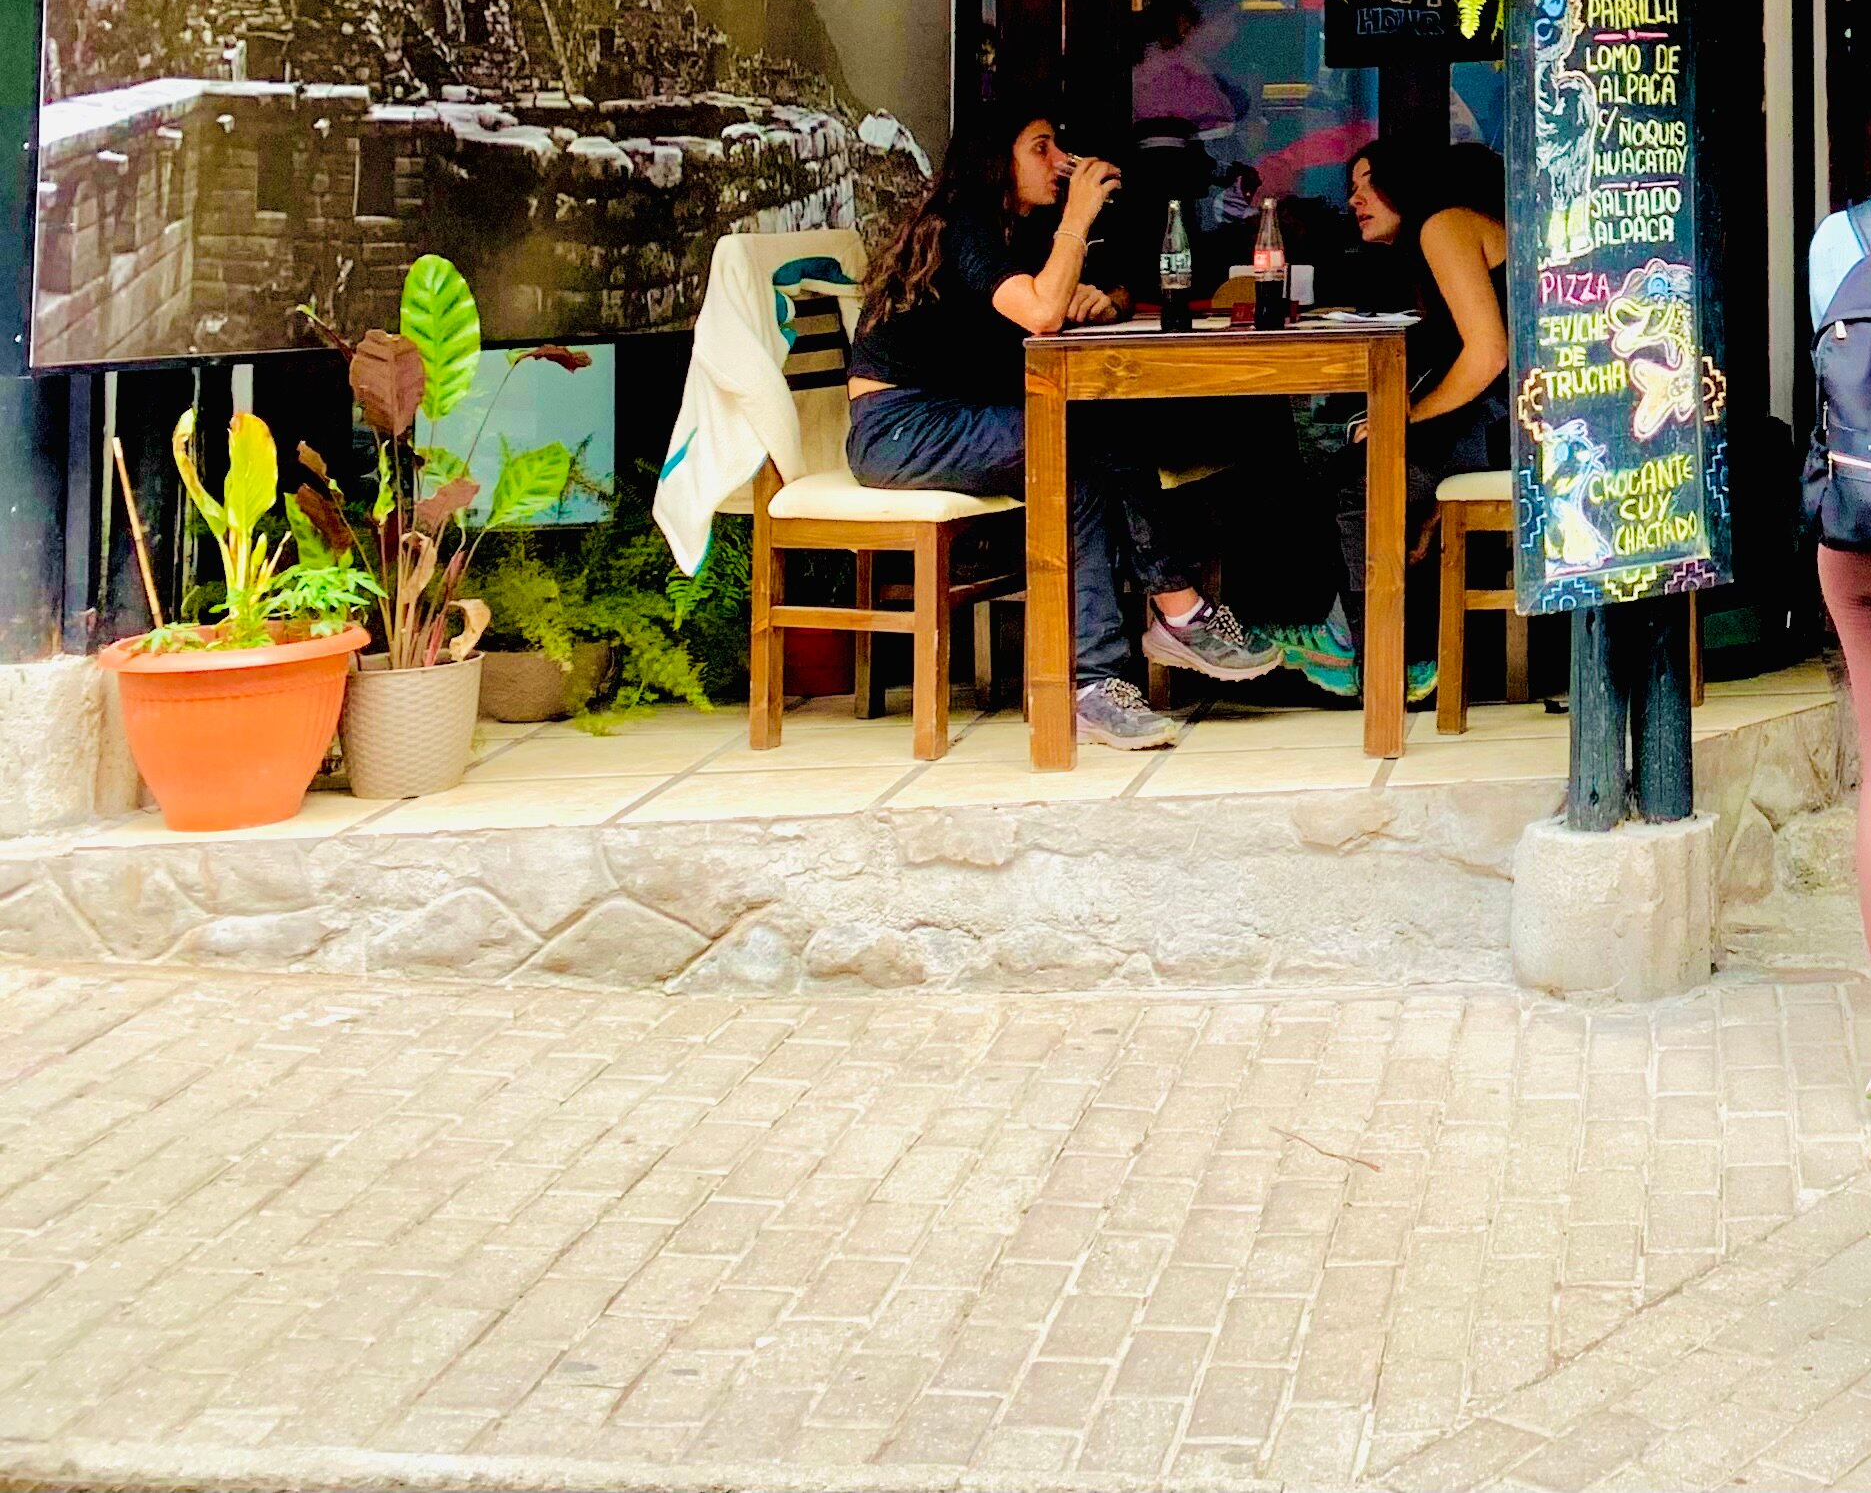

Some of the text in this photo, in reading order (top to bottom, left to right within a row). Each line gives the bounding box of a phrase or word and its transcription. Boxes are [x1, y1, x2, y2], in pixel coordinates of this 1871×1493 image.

[1586, 43, 1681, 75] LOMO DE
[1598, 73, 1677, 106] ALPACA
[1618, 116, 1687, 148] ÑOQUIS
[1594, 145, 1689, 178] HUACATAY
[1590, 187, 1682, 219] SALTADO
[1593, 215, 1675, 248] ALPACA
[1540, 270, 1611, 306] PIZZA
[1555, 346, 1587, 368] DE
[1540, 360, 1628, 400] TRUCHA
[1588, 454, 1695, 504] CROCANTE
[1619, 491, 1672, 521] CUY
[1614, 510, 1698, 556] CHACTADO
